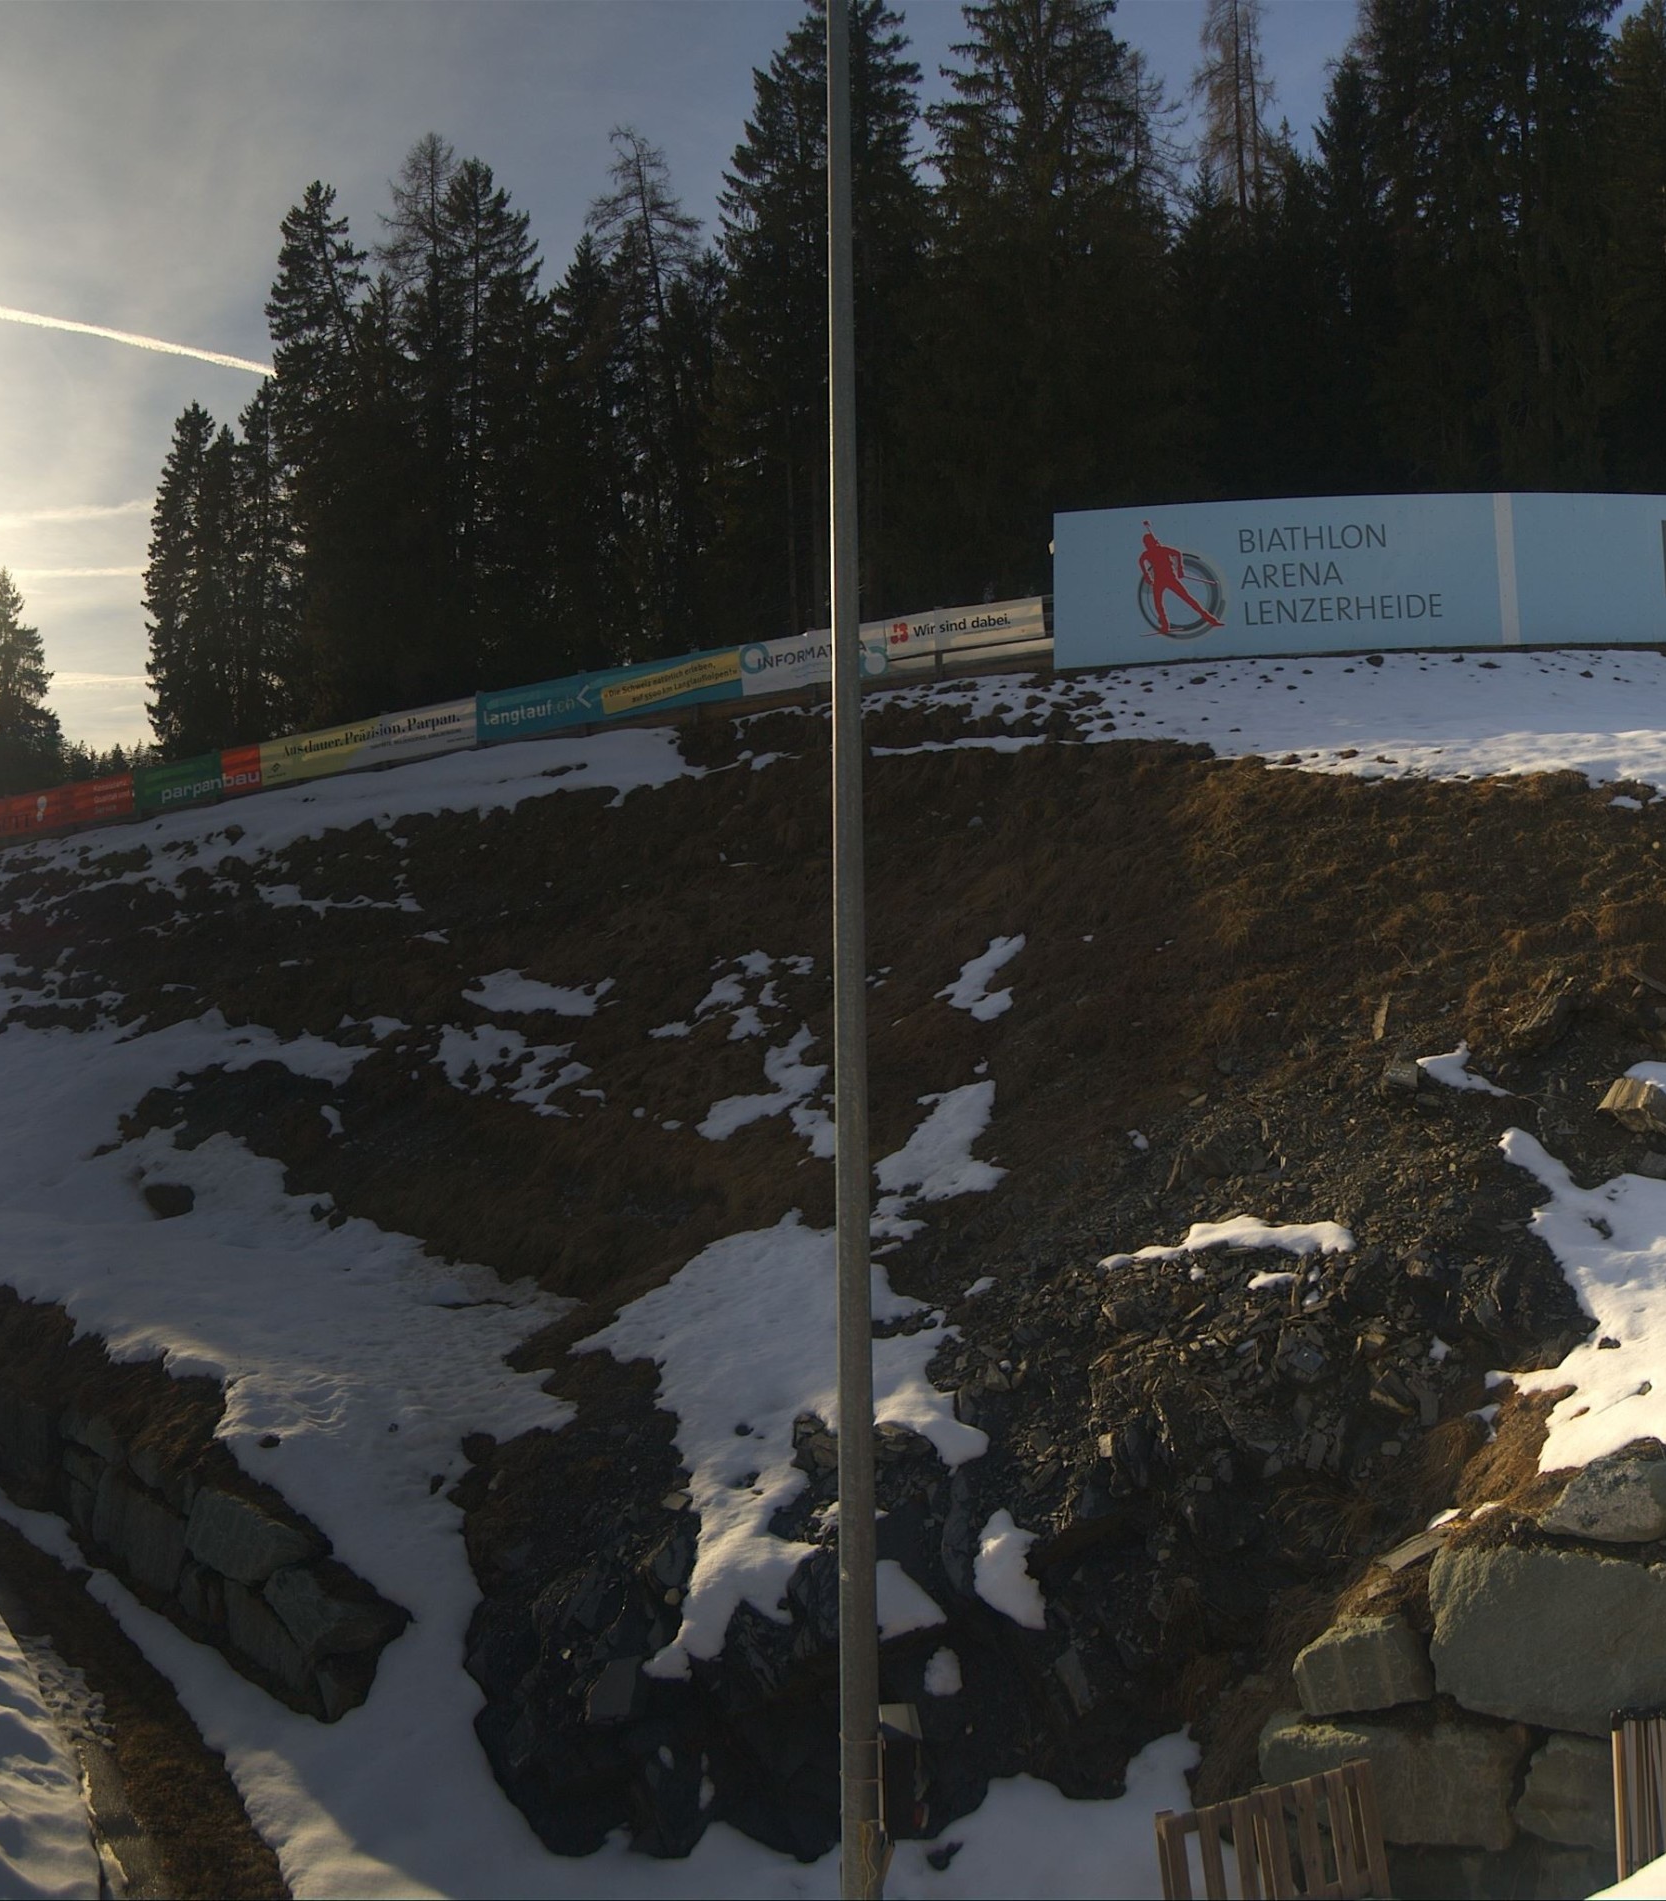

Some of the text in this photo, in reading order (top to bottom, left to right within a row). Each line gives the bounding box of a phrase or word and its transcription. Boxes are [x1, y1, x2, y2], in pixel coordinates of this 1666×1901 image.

[1239, 523, 1388, 553] BIATHLON
[1240, 562, 1344, 589] ARENA
[1244, 592, 1443, 626] LENZERHEIDE
[914, 624, 935, 638] Wir
[940, 618, 966, 633] sind
[972, 613, 1011, 630] dabei.
[757, 640, 867, 670] INFORMATA
[161, 771, 261, 804] parpanbau
